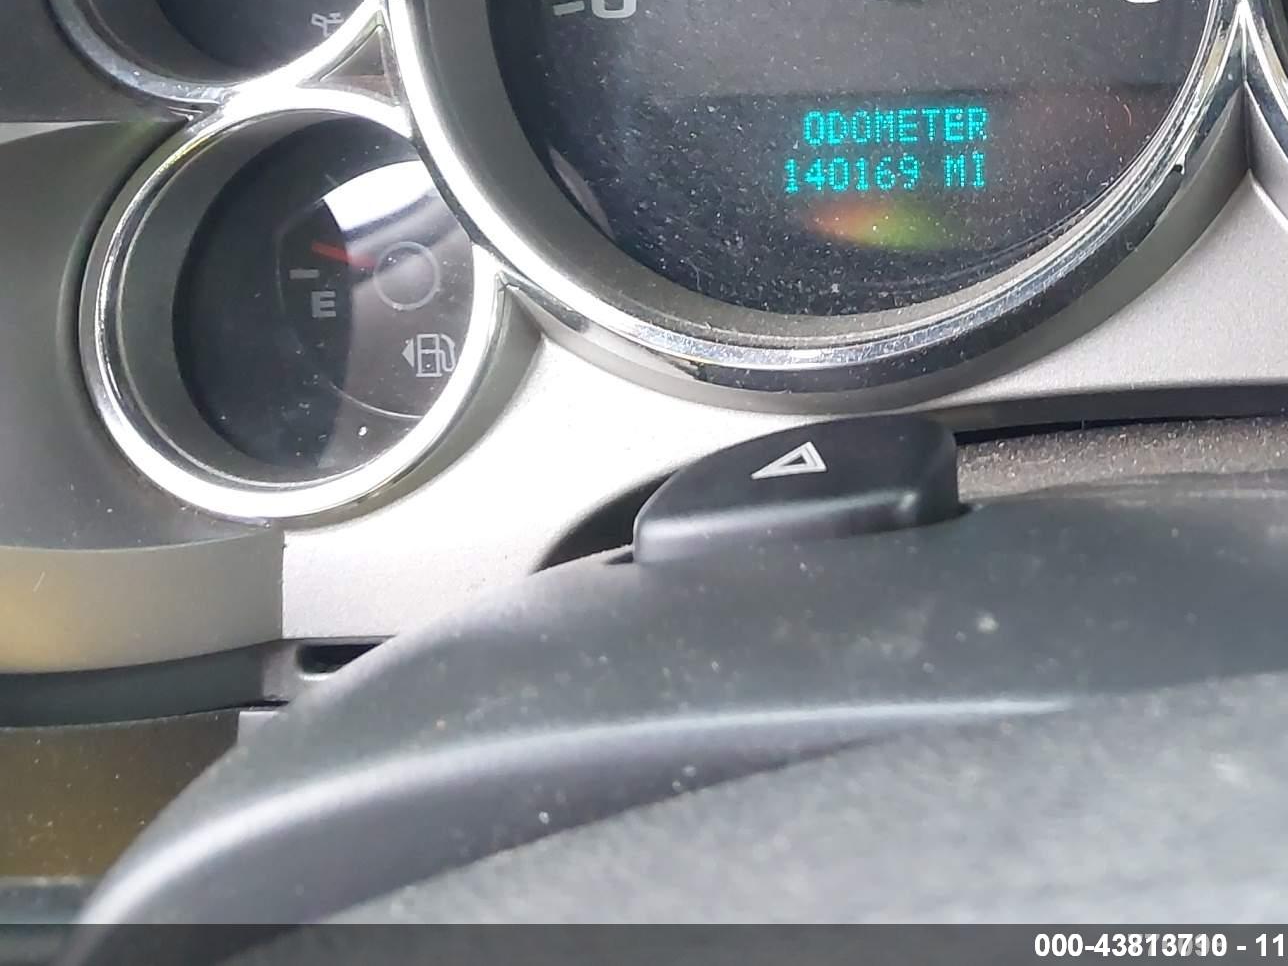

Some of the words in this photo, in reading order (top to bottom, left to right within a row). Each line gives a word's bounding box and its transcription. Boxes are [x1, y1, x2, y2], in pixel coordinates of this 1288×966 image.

[803, 106, 988, 147] ODOMETER
[783, 154, 921, 195] 140169
[943, 152, 986, 188] MI
[311, 291, 337, 318] E
